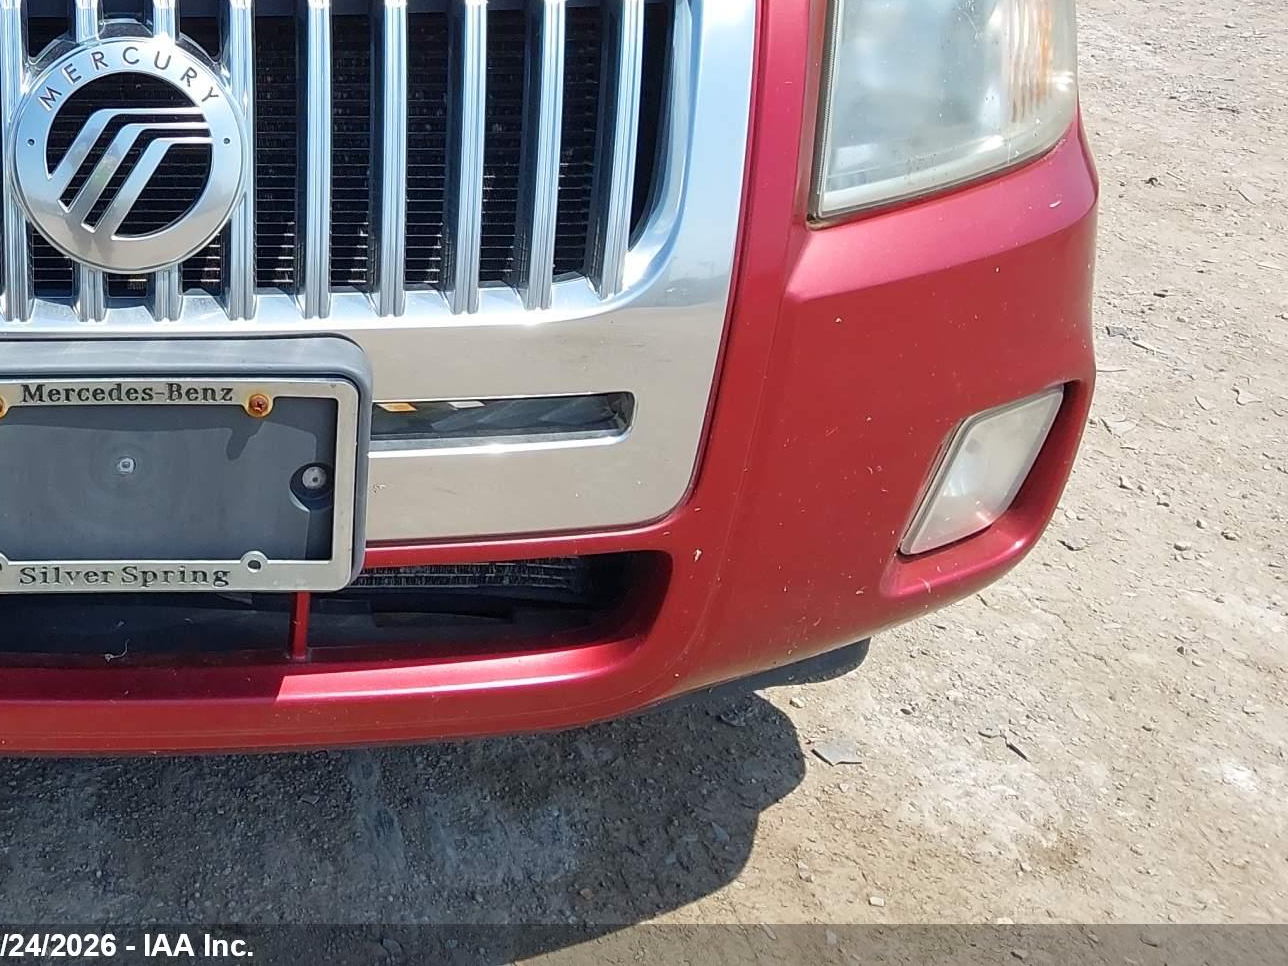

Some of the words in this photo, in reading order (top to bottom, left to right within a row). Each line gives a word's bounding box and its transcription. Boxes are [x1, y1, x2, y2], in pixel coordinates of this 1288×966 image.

[39, 46, 219, 111] MERCURY
[20, 382, 234, 404] Mercedes-Benz
[19, 566, 115, 584] Silver
[120, 565, 231, 587] Spring
